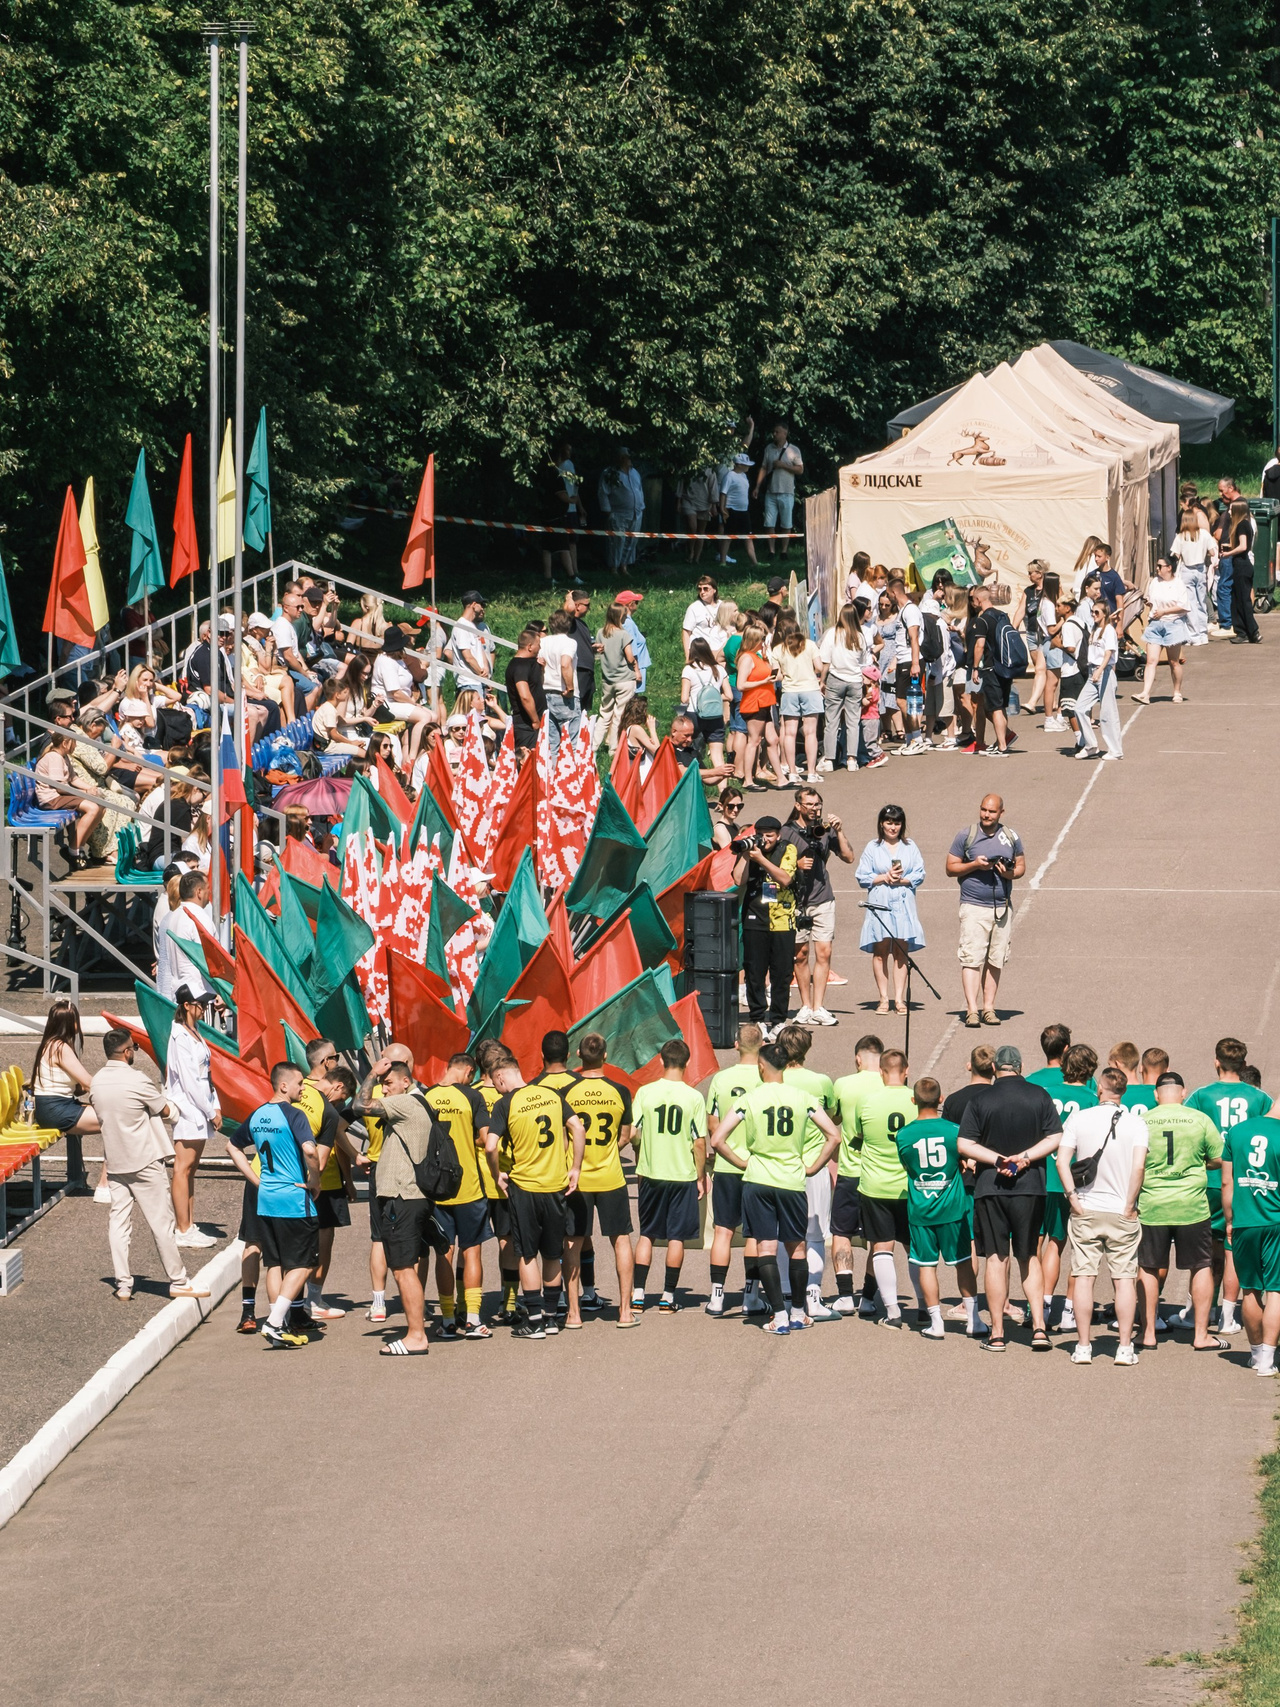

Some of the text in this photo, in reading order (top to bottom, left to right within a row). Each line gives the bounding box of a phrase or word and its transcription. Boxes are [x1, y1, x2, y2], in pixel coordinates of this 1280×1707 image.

[863, 474, 923, 489] ЛІДСКАЕ
[994, 549, 1010, 561] 76
[517, 1100, 557, 1113] «ДОЛОМИТ»
[526, 1094, 541, 1103] ОАО
[570, 1099, 617, 1107] «ДОЛОМИТ»
[1216, 1096, 1248, 1128] 13
[535, 1114, 555, 1149] 3
[576, 1111, 614, 1147] 23
[654, 1103, 683, 1136] 10
[763, 1105, 794, 1137] 18
[887, 1111, 906, 1143] 9
[259, 1140, 275, 1174] 1
[912, 1136, 948, 1169] 15
[1163, 1130, 1174, 1166] 1
[1248, 1135, 1269, 1168] 3
